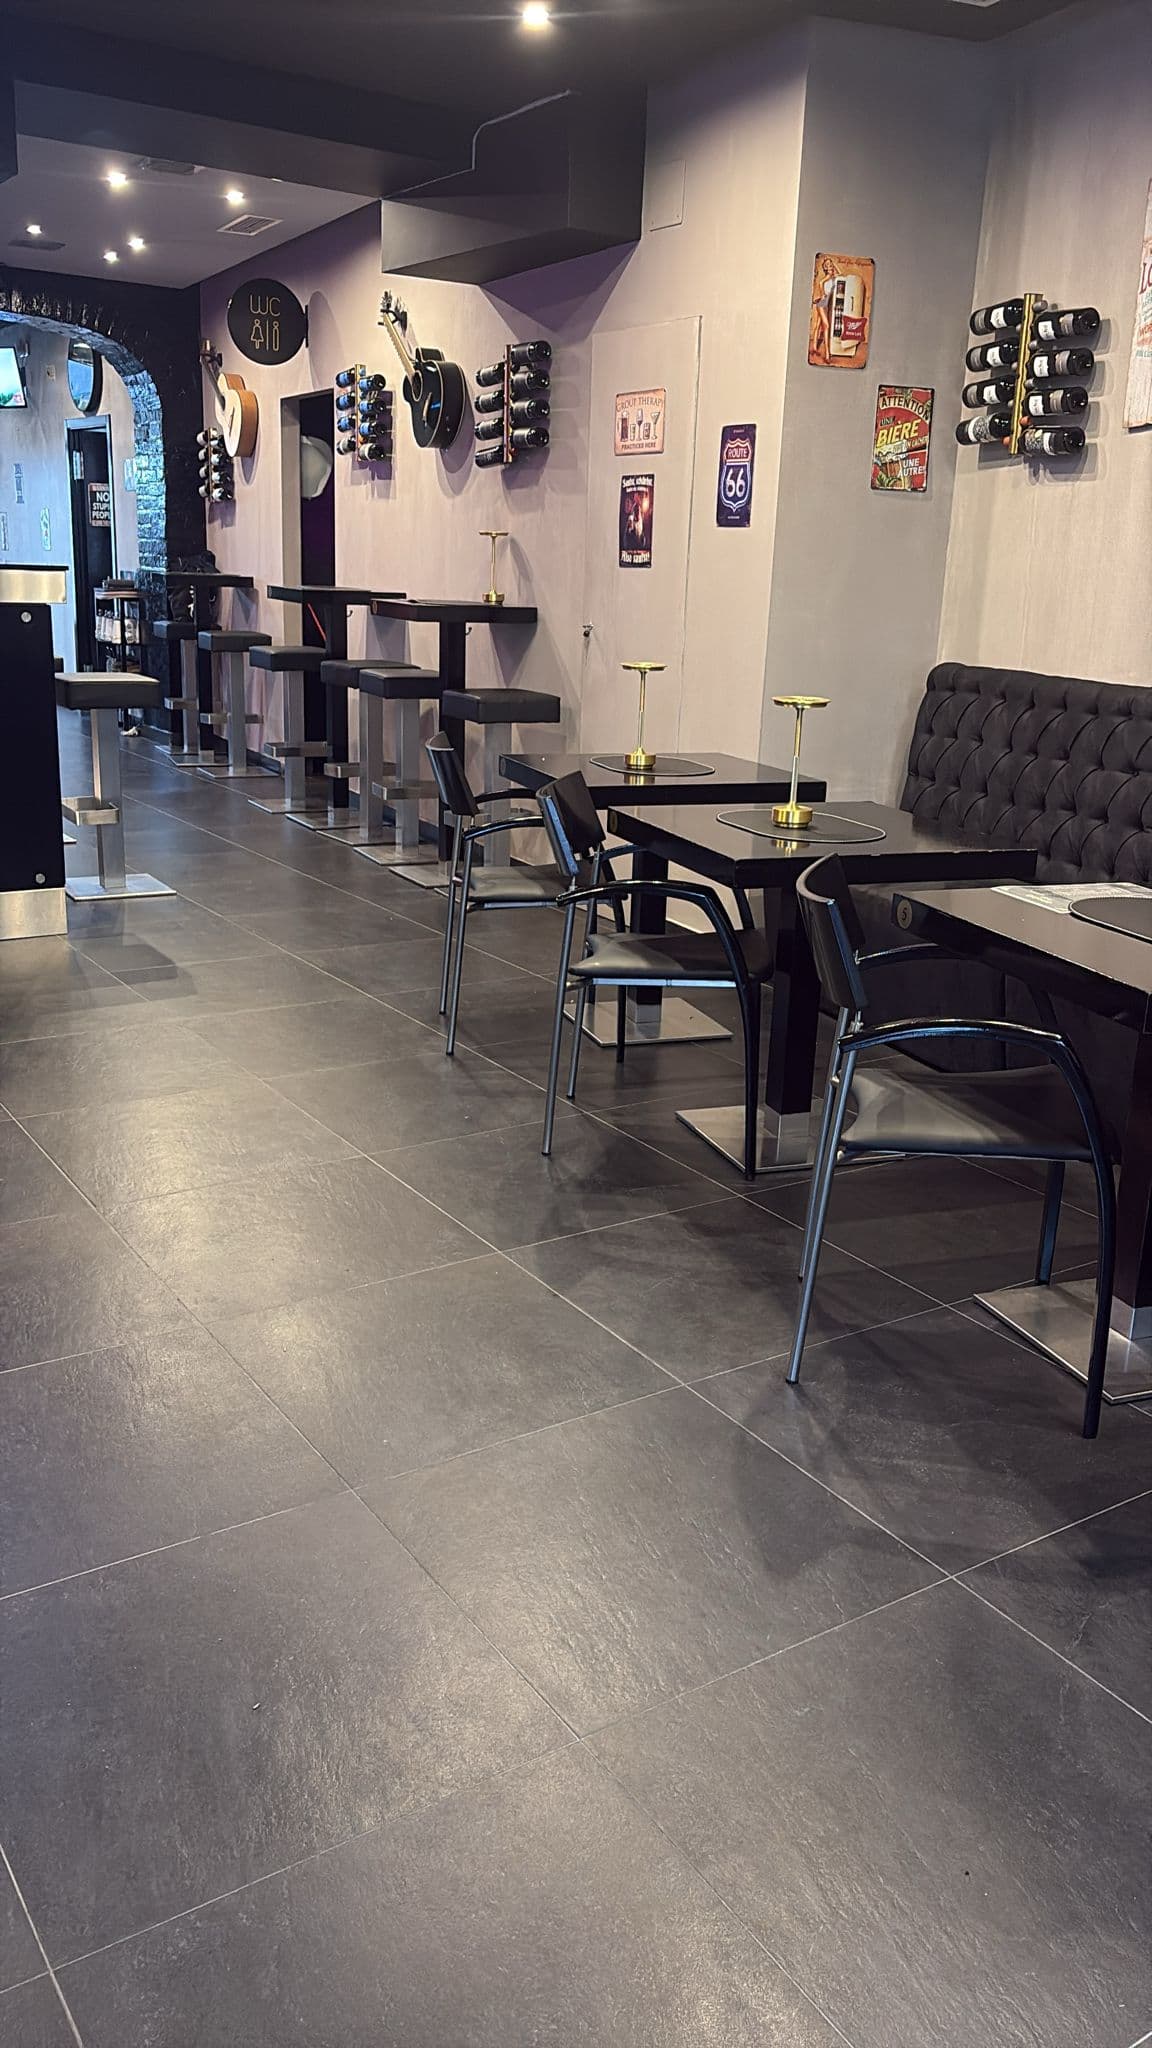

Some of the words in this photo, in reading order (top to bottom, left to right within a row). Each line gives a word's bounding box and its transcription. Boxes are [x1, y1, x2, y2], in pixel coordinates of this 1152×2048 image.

[249, 294, 281, 317] WC
[881, 396, 930, 421] ATTENTION
[876, 419, 921, 448] BIÈRE
[727, 448, 748, 458] ROUTE
[903, 457, 920, 467] UNE
[726, 467, 746, 498] 66
[96, 491, 110, 502] NO
[92, 502, 110, 511] STUPI
